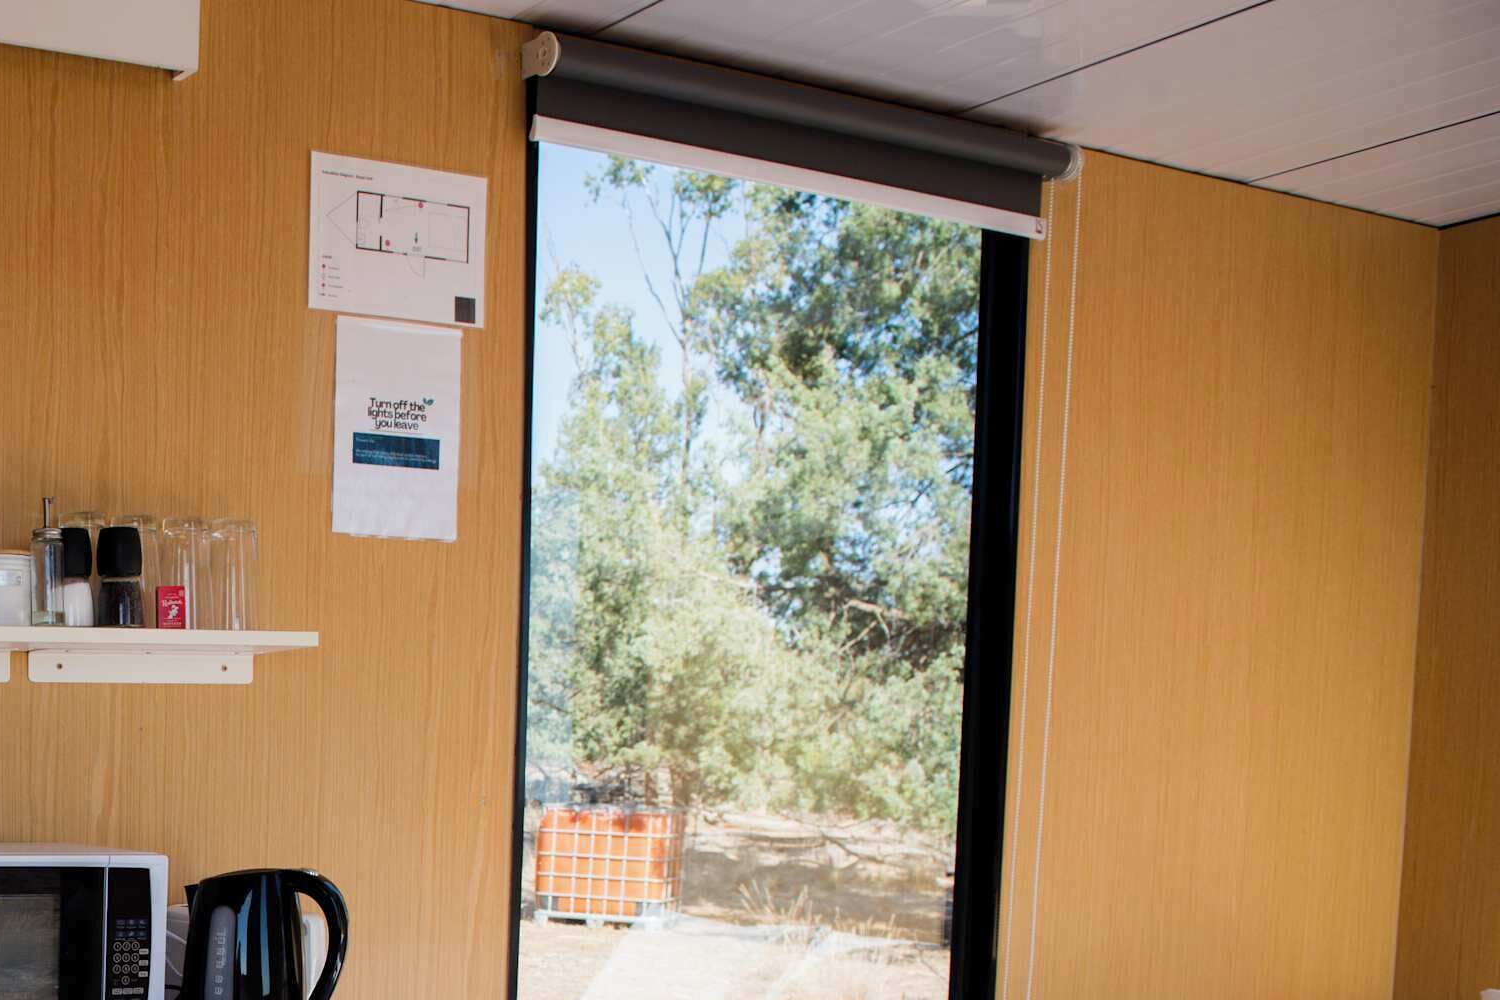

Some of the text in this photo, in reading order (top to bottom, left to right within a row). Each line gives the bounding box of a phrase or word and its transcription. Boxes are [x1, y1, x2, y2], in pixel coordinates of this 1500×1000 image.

[370, 397, 426, 412] Turn off the
[368, 406, 427, 422] lights before
[375, 418, 419, 430] you leave
